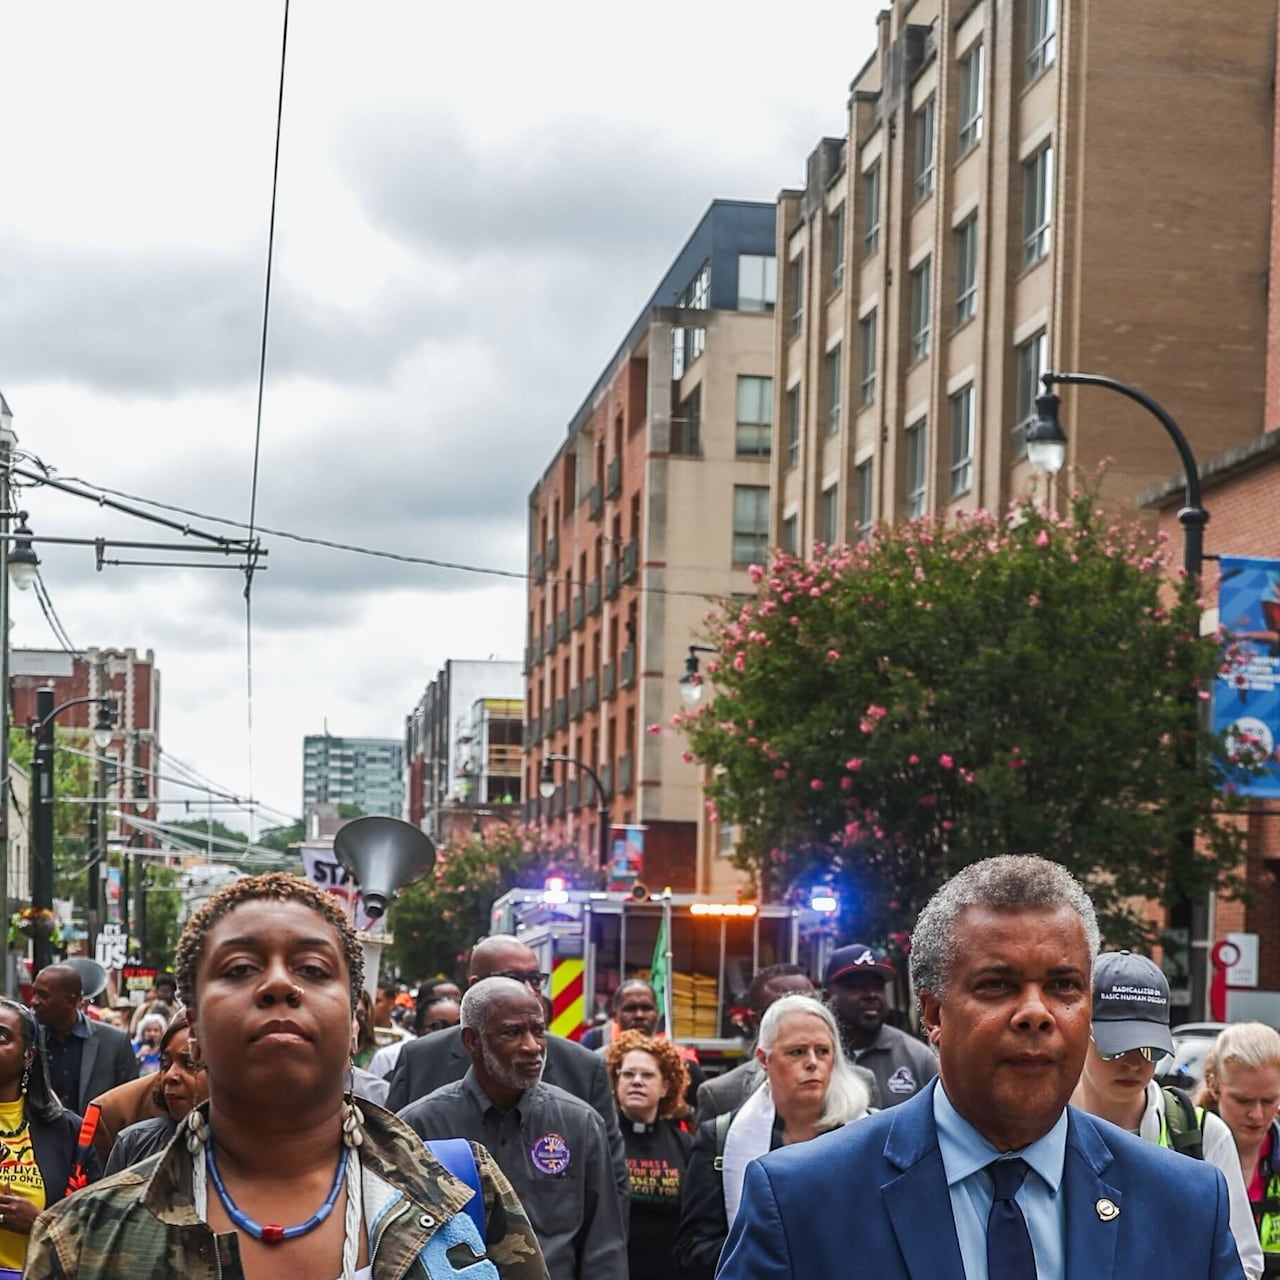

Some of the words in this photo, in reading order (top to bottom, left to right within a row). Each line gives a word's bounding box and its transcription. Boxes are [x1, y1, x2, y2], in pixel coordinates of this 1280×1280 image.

[95, 944, 127, 969] US
[854, 950, 876, 965] A
[1112, 986, 1154, 996] RADICALIZED
[19, 1175, 33, 1183] ON
